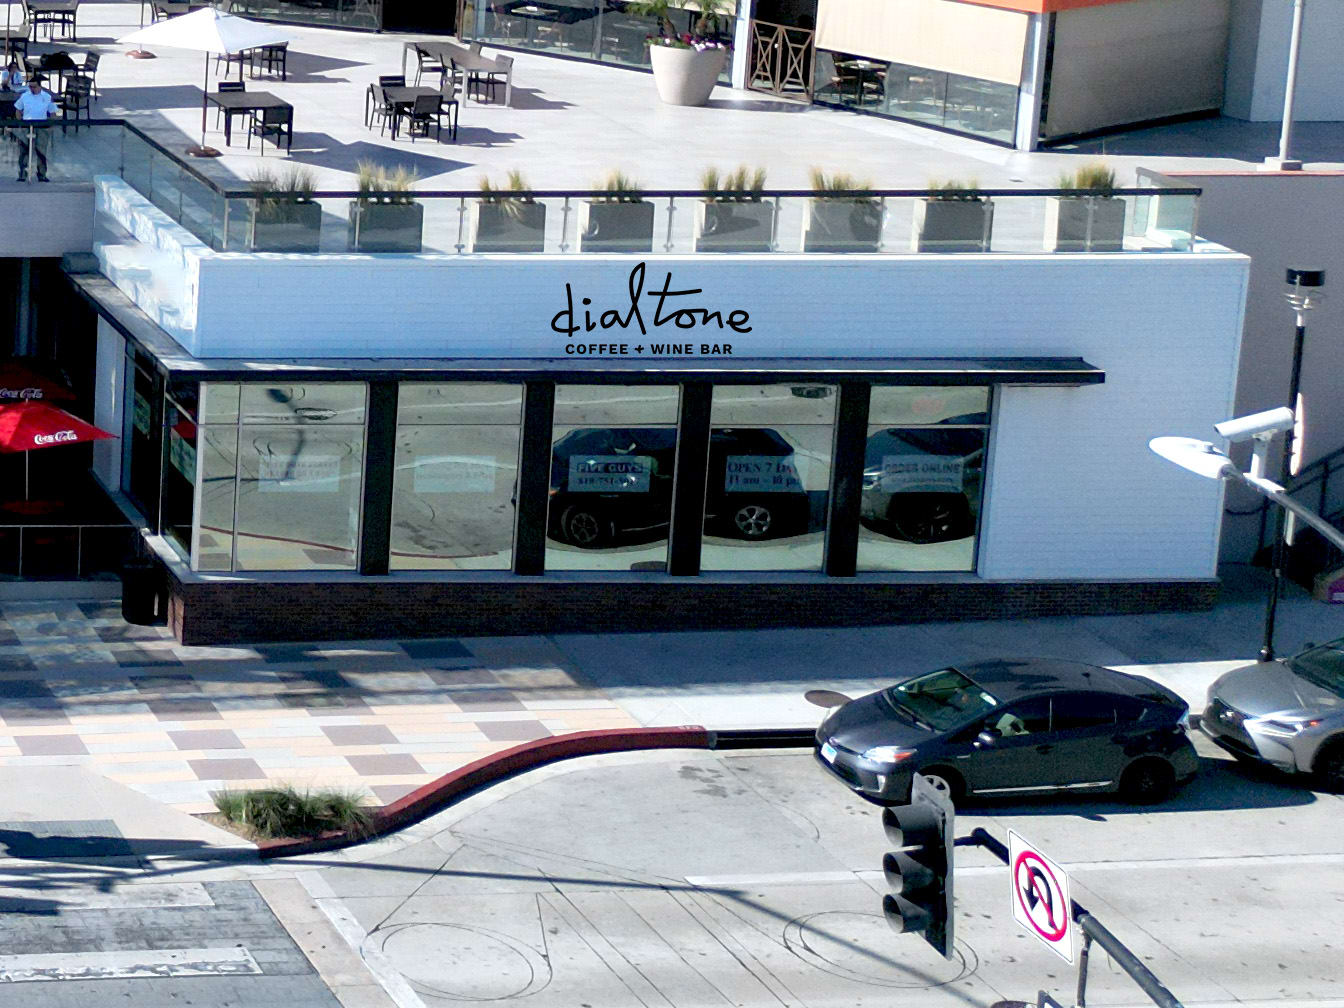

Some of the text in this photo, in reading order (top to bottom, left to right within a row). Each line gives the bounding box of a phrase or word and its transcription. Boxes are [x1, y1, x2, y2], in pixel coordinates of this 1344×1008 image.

[551, 262, 752, 337] dialtone
[565, 344, 629, 355] COFFEE
[651, 344, 694, 355] WINE
[700, 344, 733, 355] BAR
[608, 463, 642, 473] GUYS
[728, 463, 761, 473] OPEN
[922, 463, 961, 473] ONLINE
